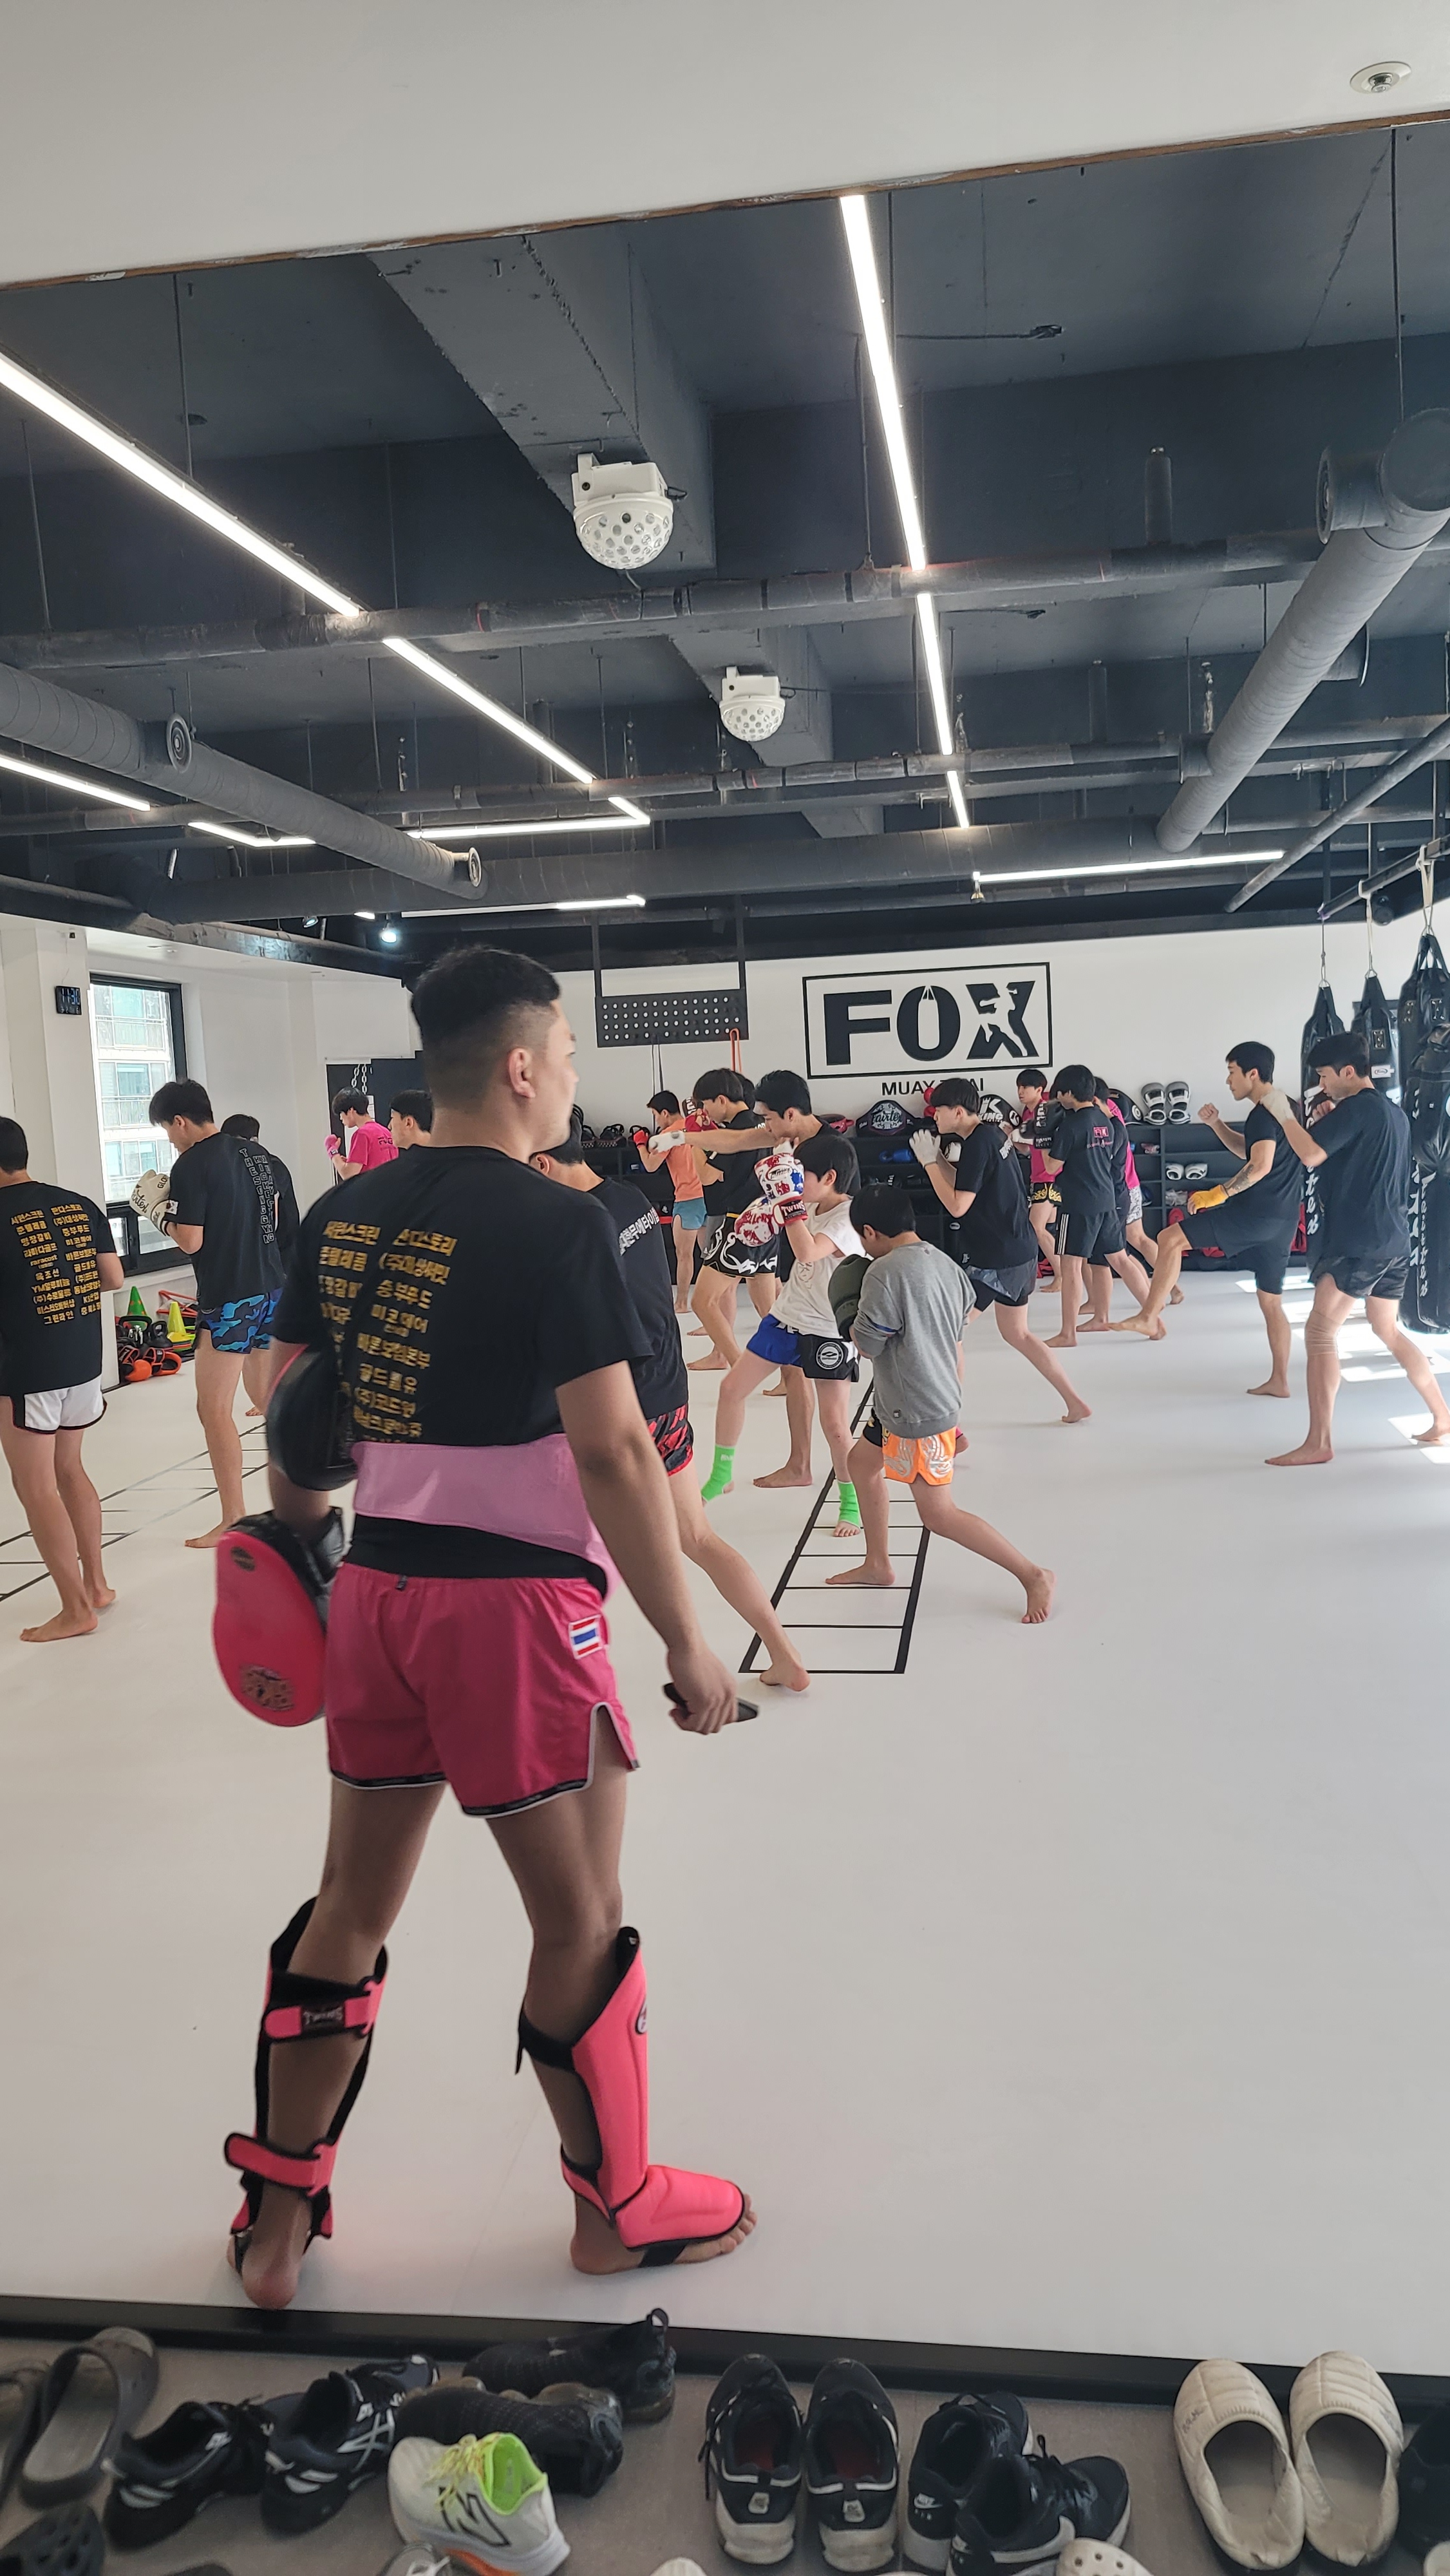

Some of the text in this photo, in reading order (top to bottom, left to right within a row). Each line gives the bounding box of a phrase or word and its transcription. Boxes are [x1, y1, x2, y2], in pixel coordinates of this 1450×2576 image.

[824, 981, 1039, 1066] FOX
[882, 1080, 936, 1095] MUAY
[781, 1200, 805, 1216] TWINS
[44, 1310, 75, 1325] 그린라인
